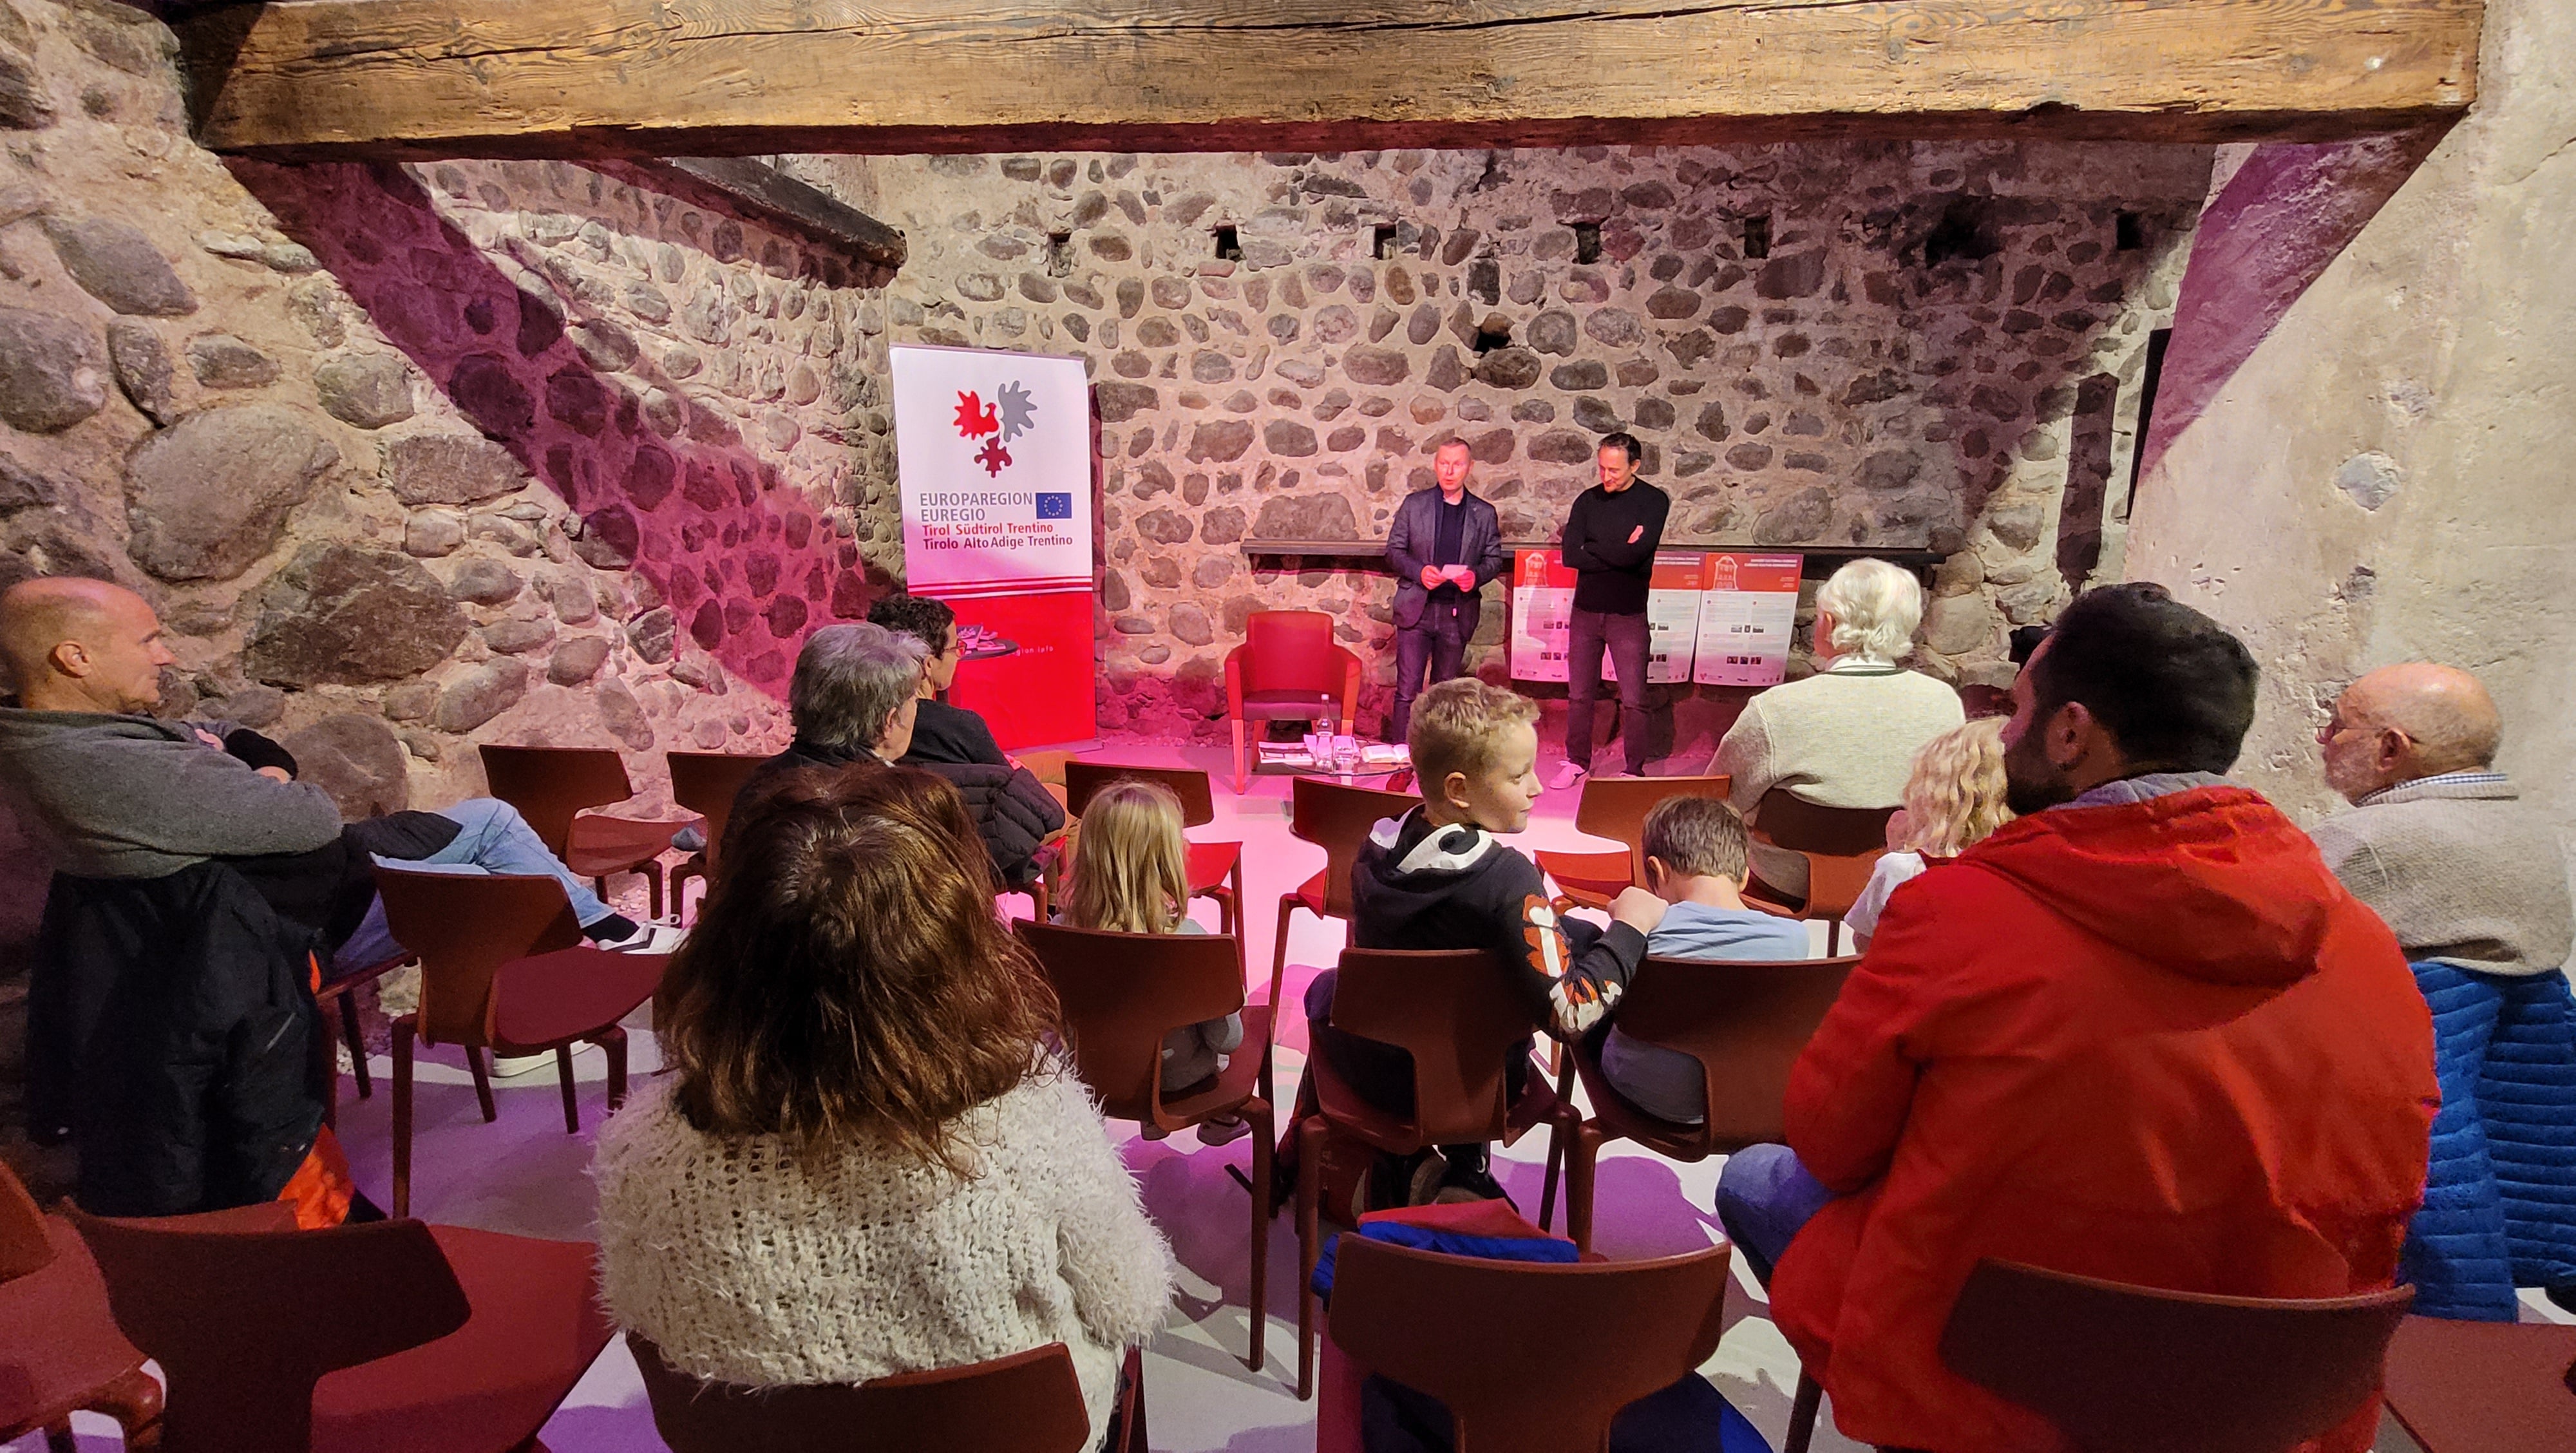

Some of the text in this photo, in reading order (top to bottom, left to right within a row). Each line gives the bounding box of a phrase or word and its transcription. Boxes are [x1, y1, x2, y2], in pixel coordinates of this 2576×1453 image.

[920, 493, 1032, 506] EUROPAREGION
[922, 508, 985, 522] EUREGIO
[923, 522, 1053, 536] Tirol Südtirol Trentino
[923, 535, 1072, 550] Tirolo Alto Adige Trentino
